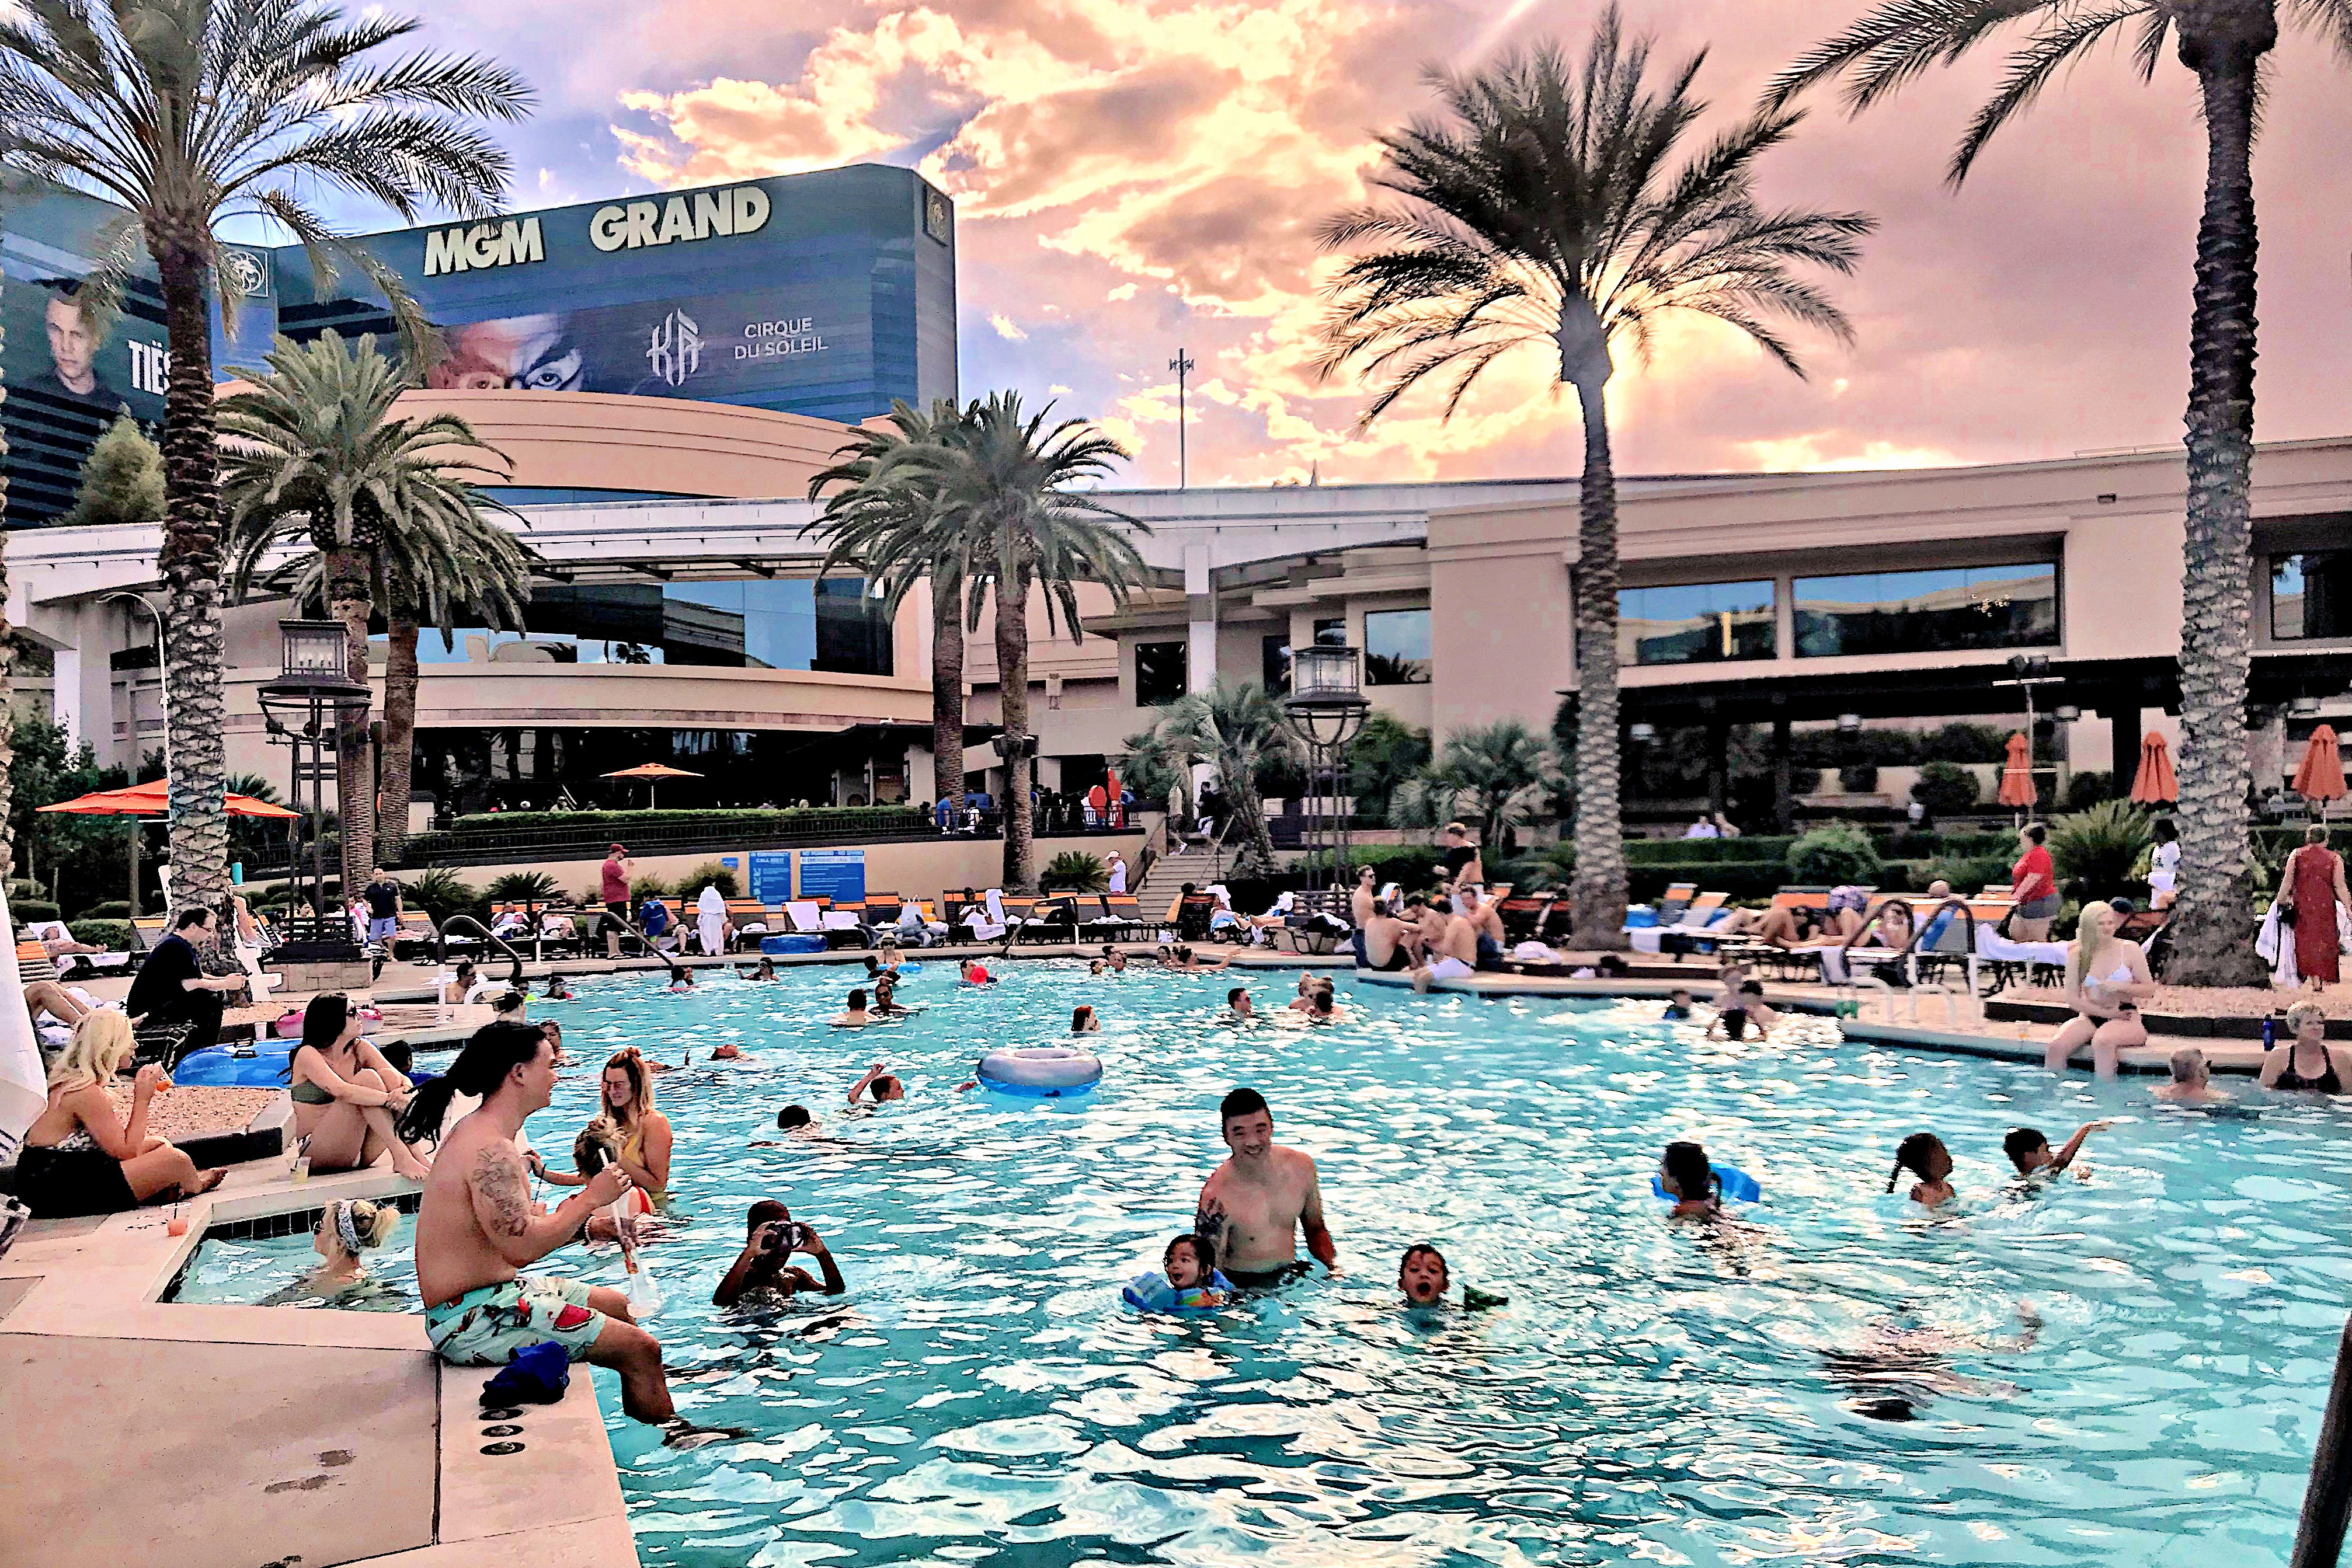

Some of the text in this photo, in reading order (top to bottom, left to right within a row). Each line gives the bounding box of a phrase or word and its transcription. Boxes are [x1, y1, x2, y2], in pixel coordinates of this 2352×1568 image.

[423, 186, 771, 277] MGM GRAND
[744, 316, 813, 339] CIRQUE
[734, 336, 829, 360] DU SOLEIL
